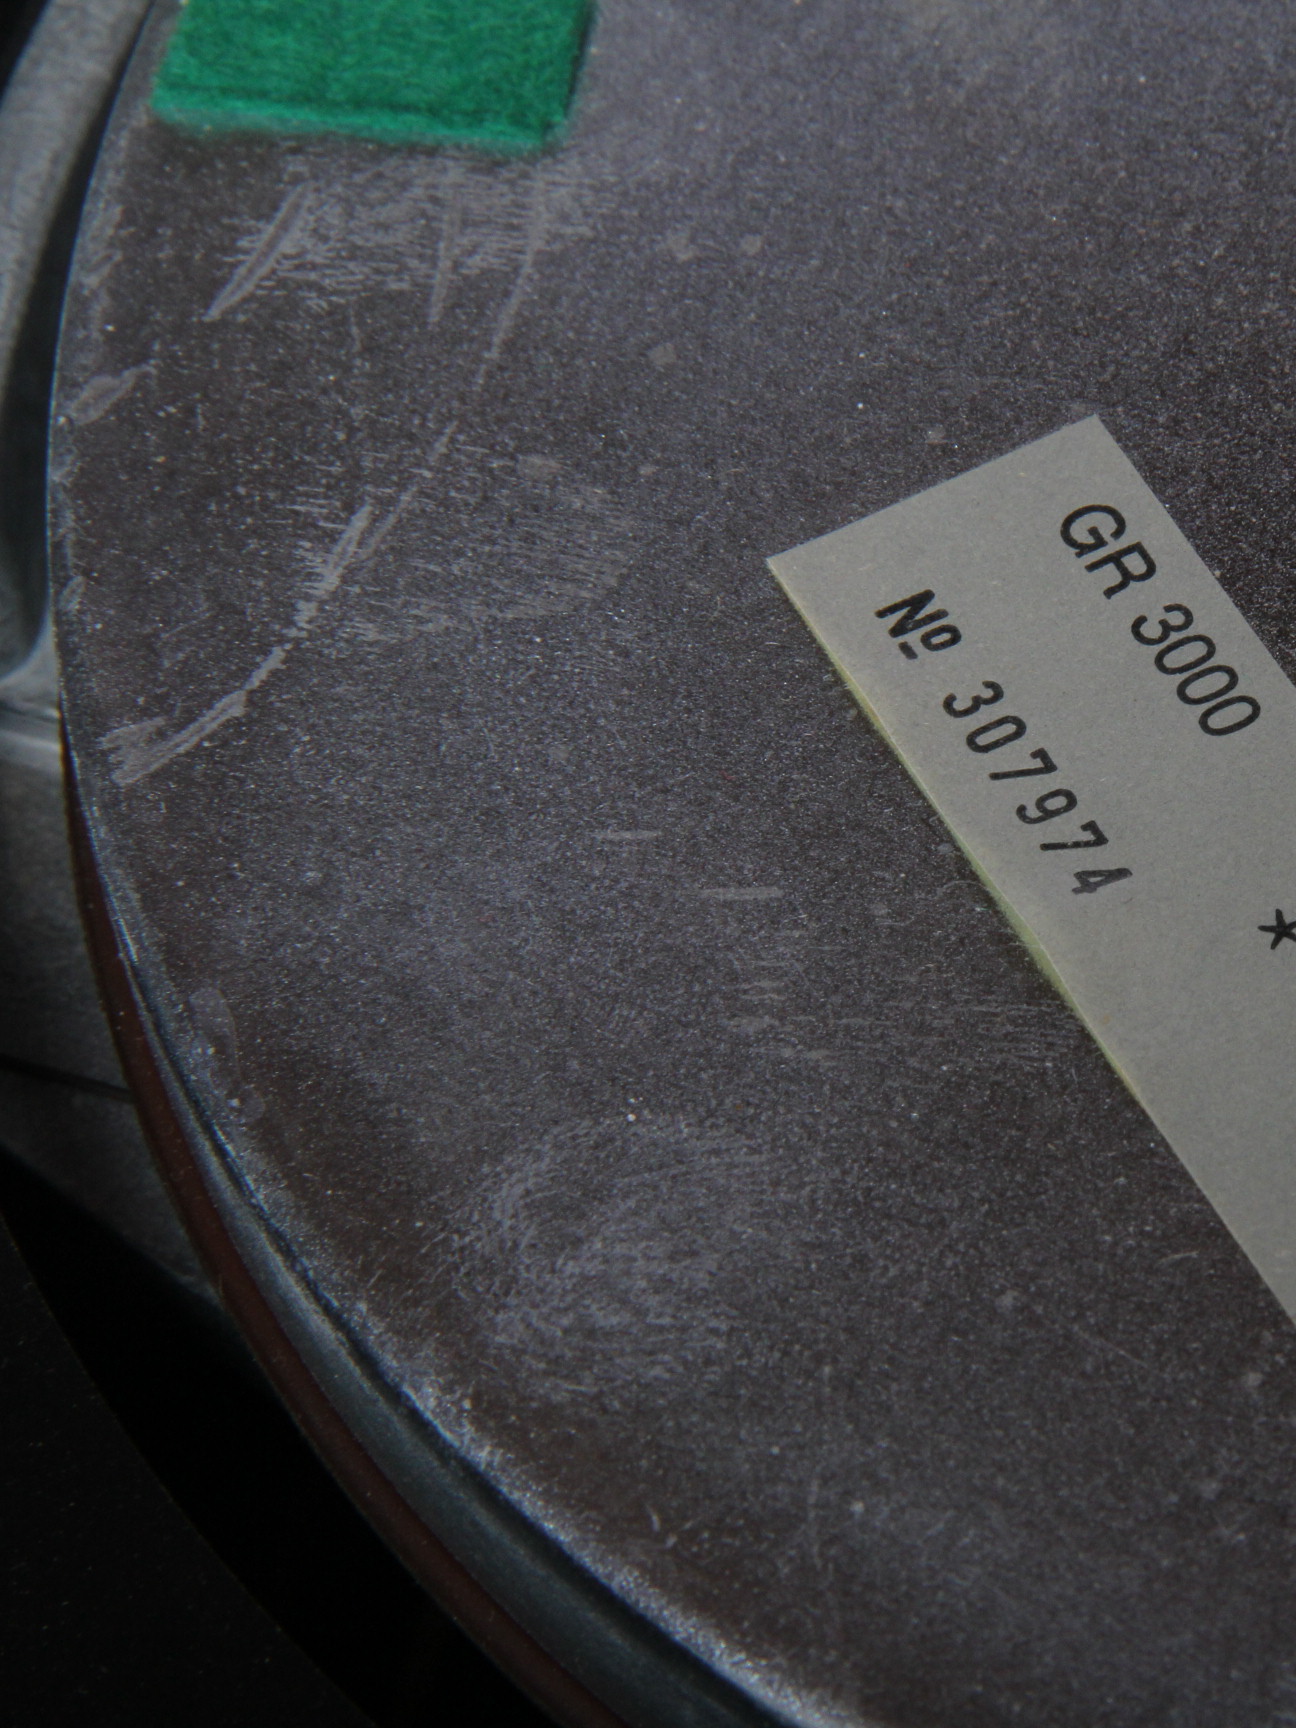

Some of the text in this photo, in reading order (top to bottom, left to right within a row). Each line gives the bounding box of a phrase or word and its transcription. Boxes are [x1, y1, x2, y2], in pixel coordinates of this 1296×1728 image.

[1059, 504, 1262, 737] GR 3000
[942, 680, 1133, 896] 307974
